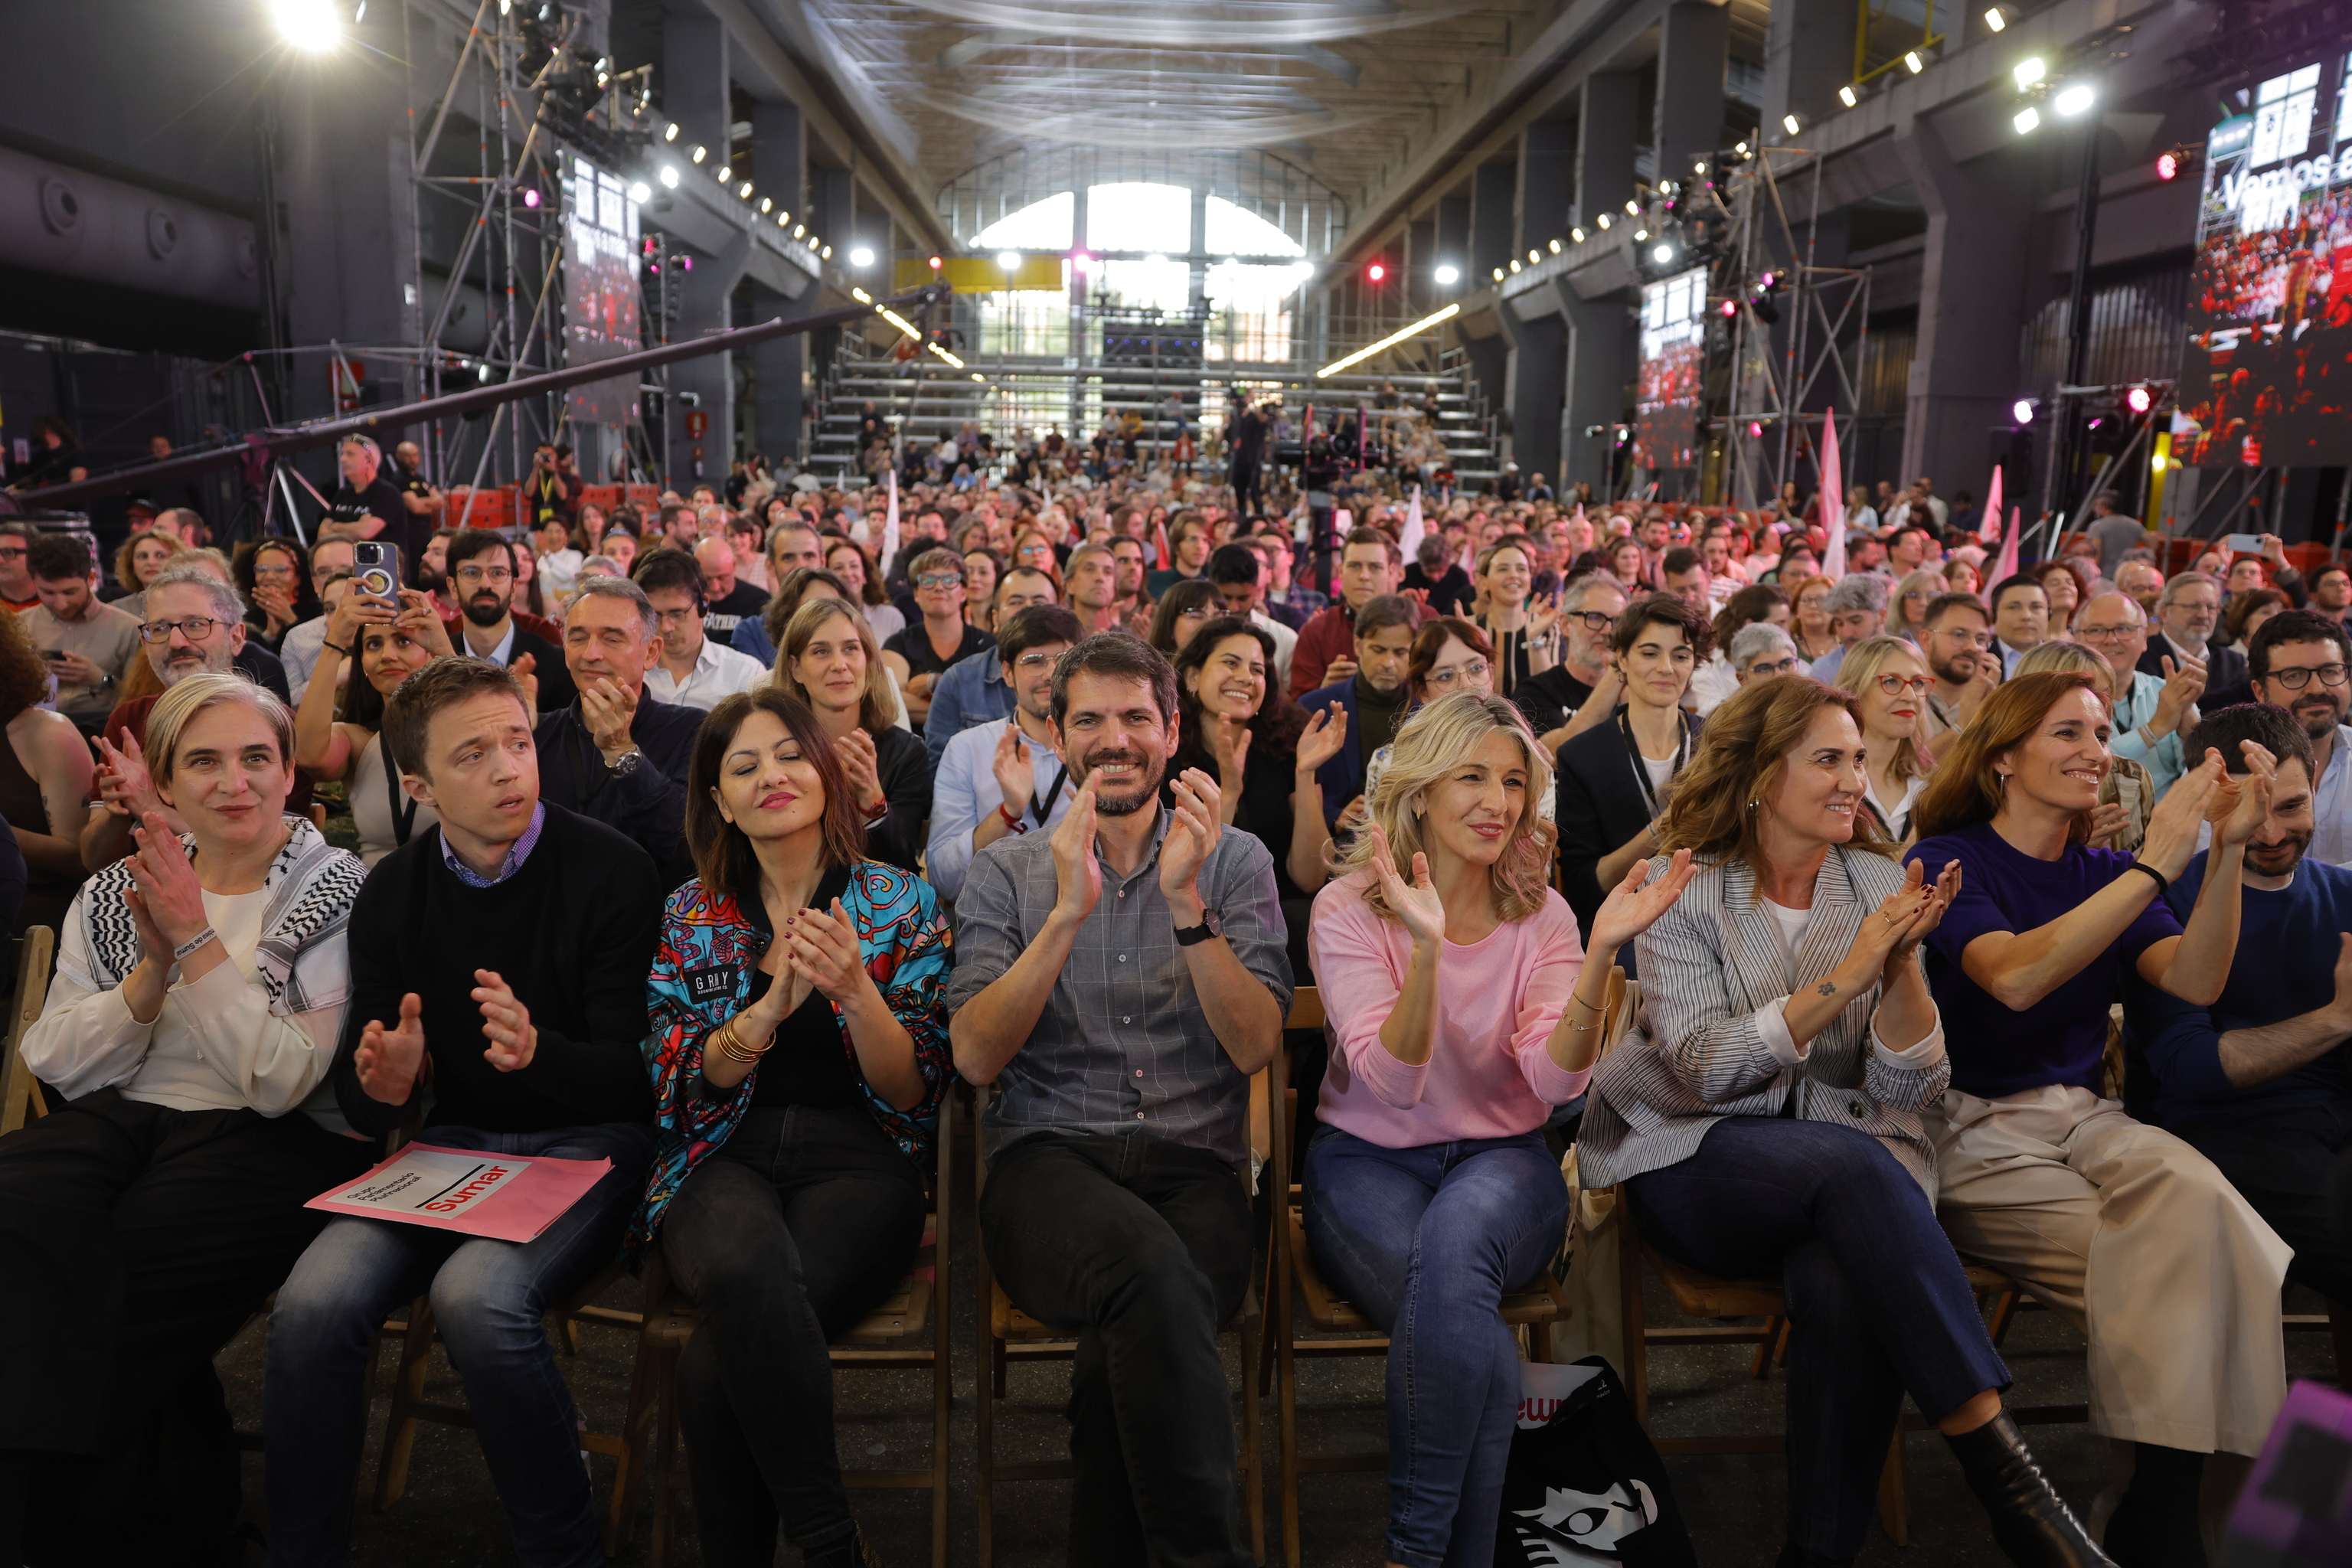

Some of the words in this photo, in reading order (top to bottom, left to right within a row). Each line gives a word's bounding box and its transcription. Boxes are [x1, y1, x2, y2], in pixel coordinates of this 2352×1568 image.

[2223, 154, 2332, 211] Vamos
[176, 942, 195, 956] Sumar
[194, 936, 204, 945] de
[347, 1186, 376, 1199] Grupo
[358, 1172, 414, 1200] Parlamentario
[369, 1176, 423, 1202] Plurinacional
[424, 1165, 509, 1212] Sumar
